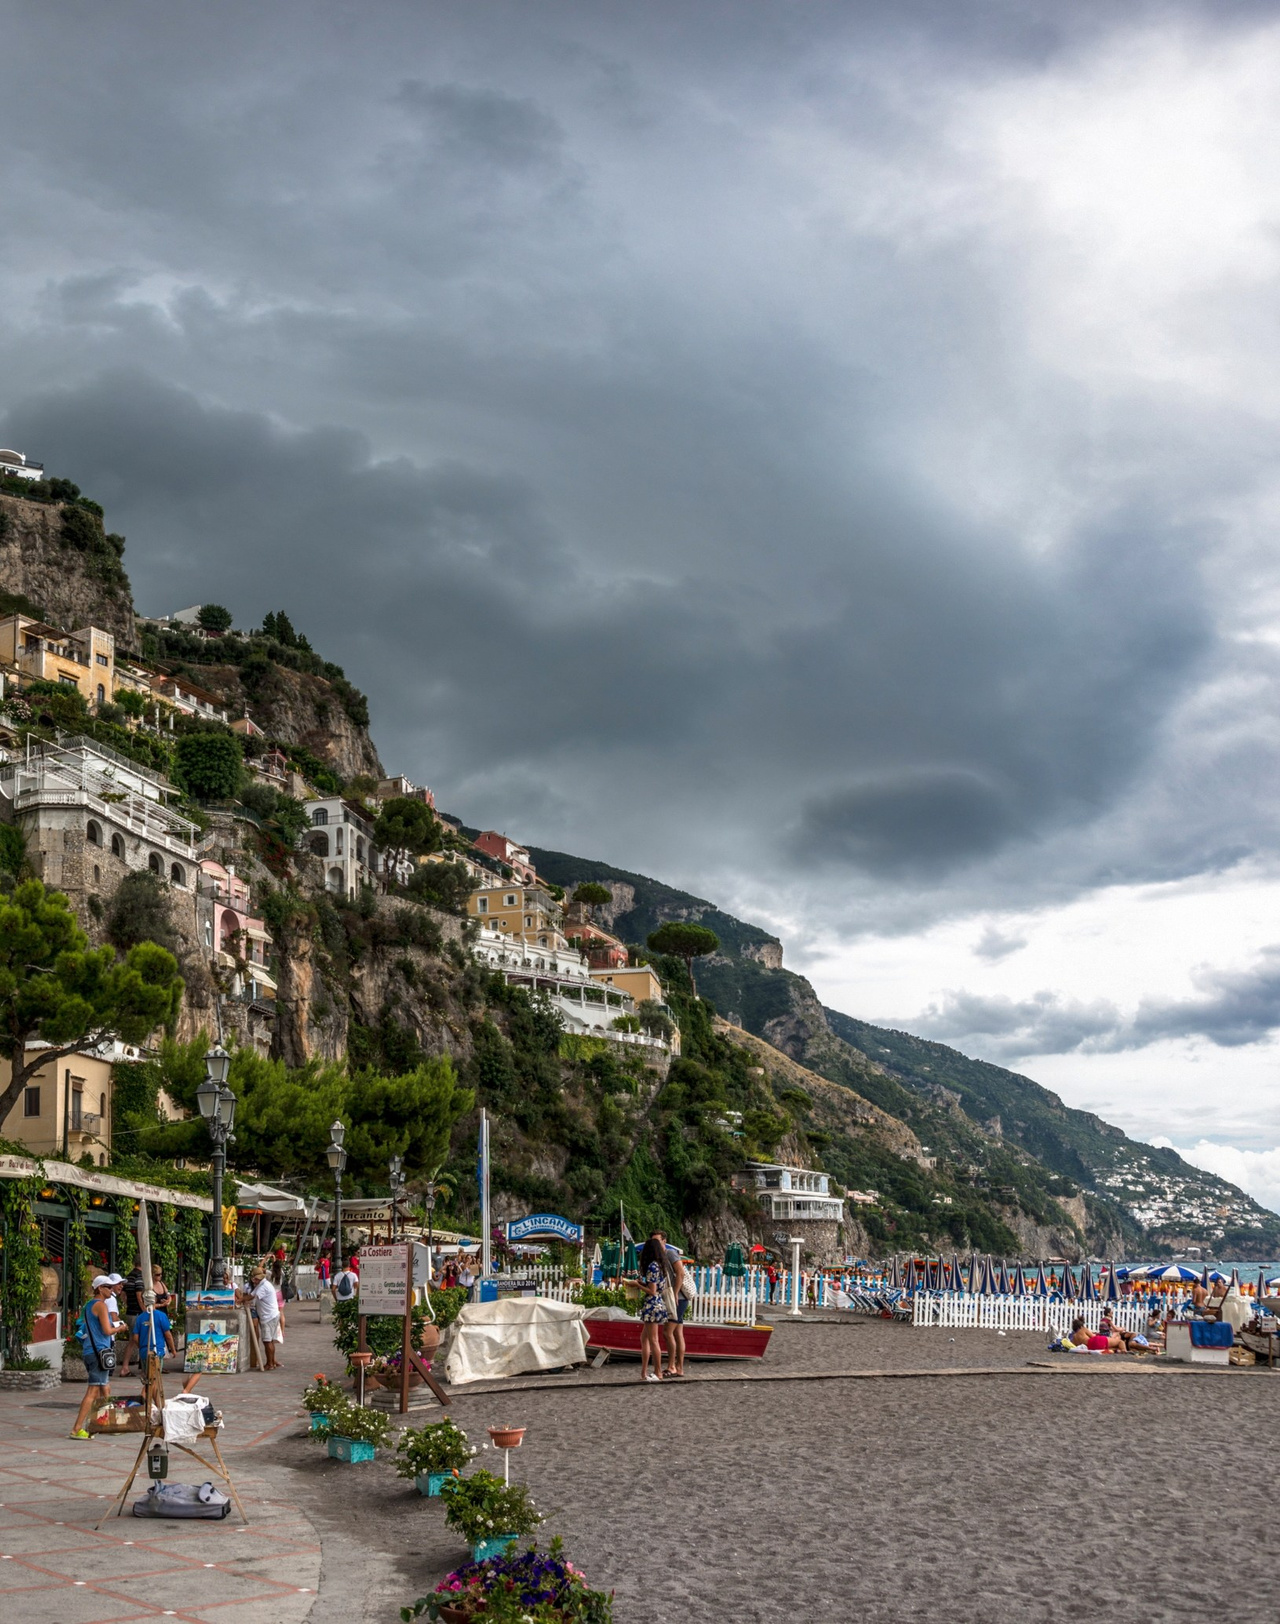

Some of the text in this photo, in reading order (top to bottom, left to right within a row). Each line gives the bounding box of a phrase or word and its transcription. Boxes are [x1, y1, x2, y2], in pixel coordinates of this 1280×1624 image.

[522, 1217, 578, 1236] L'INCANTO
[360, 1248, 367, 1257] La
[368, 1247, 392, 1257] Costiera
